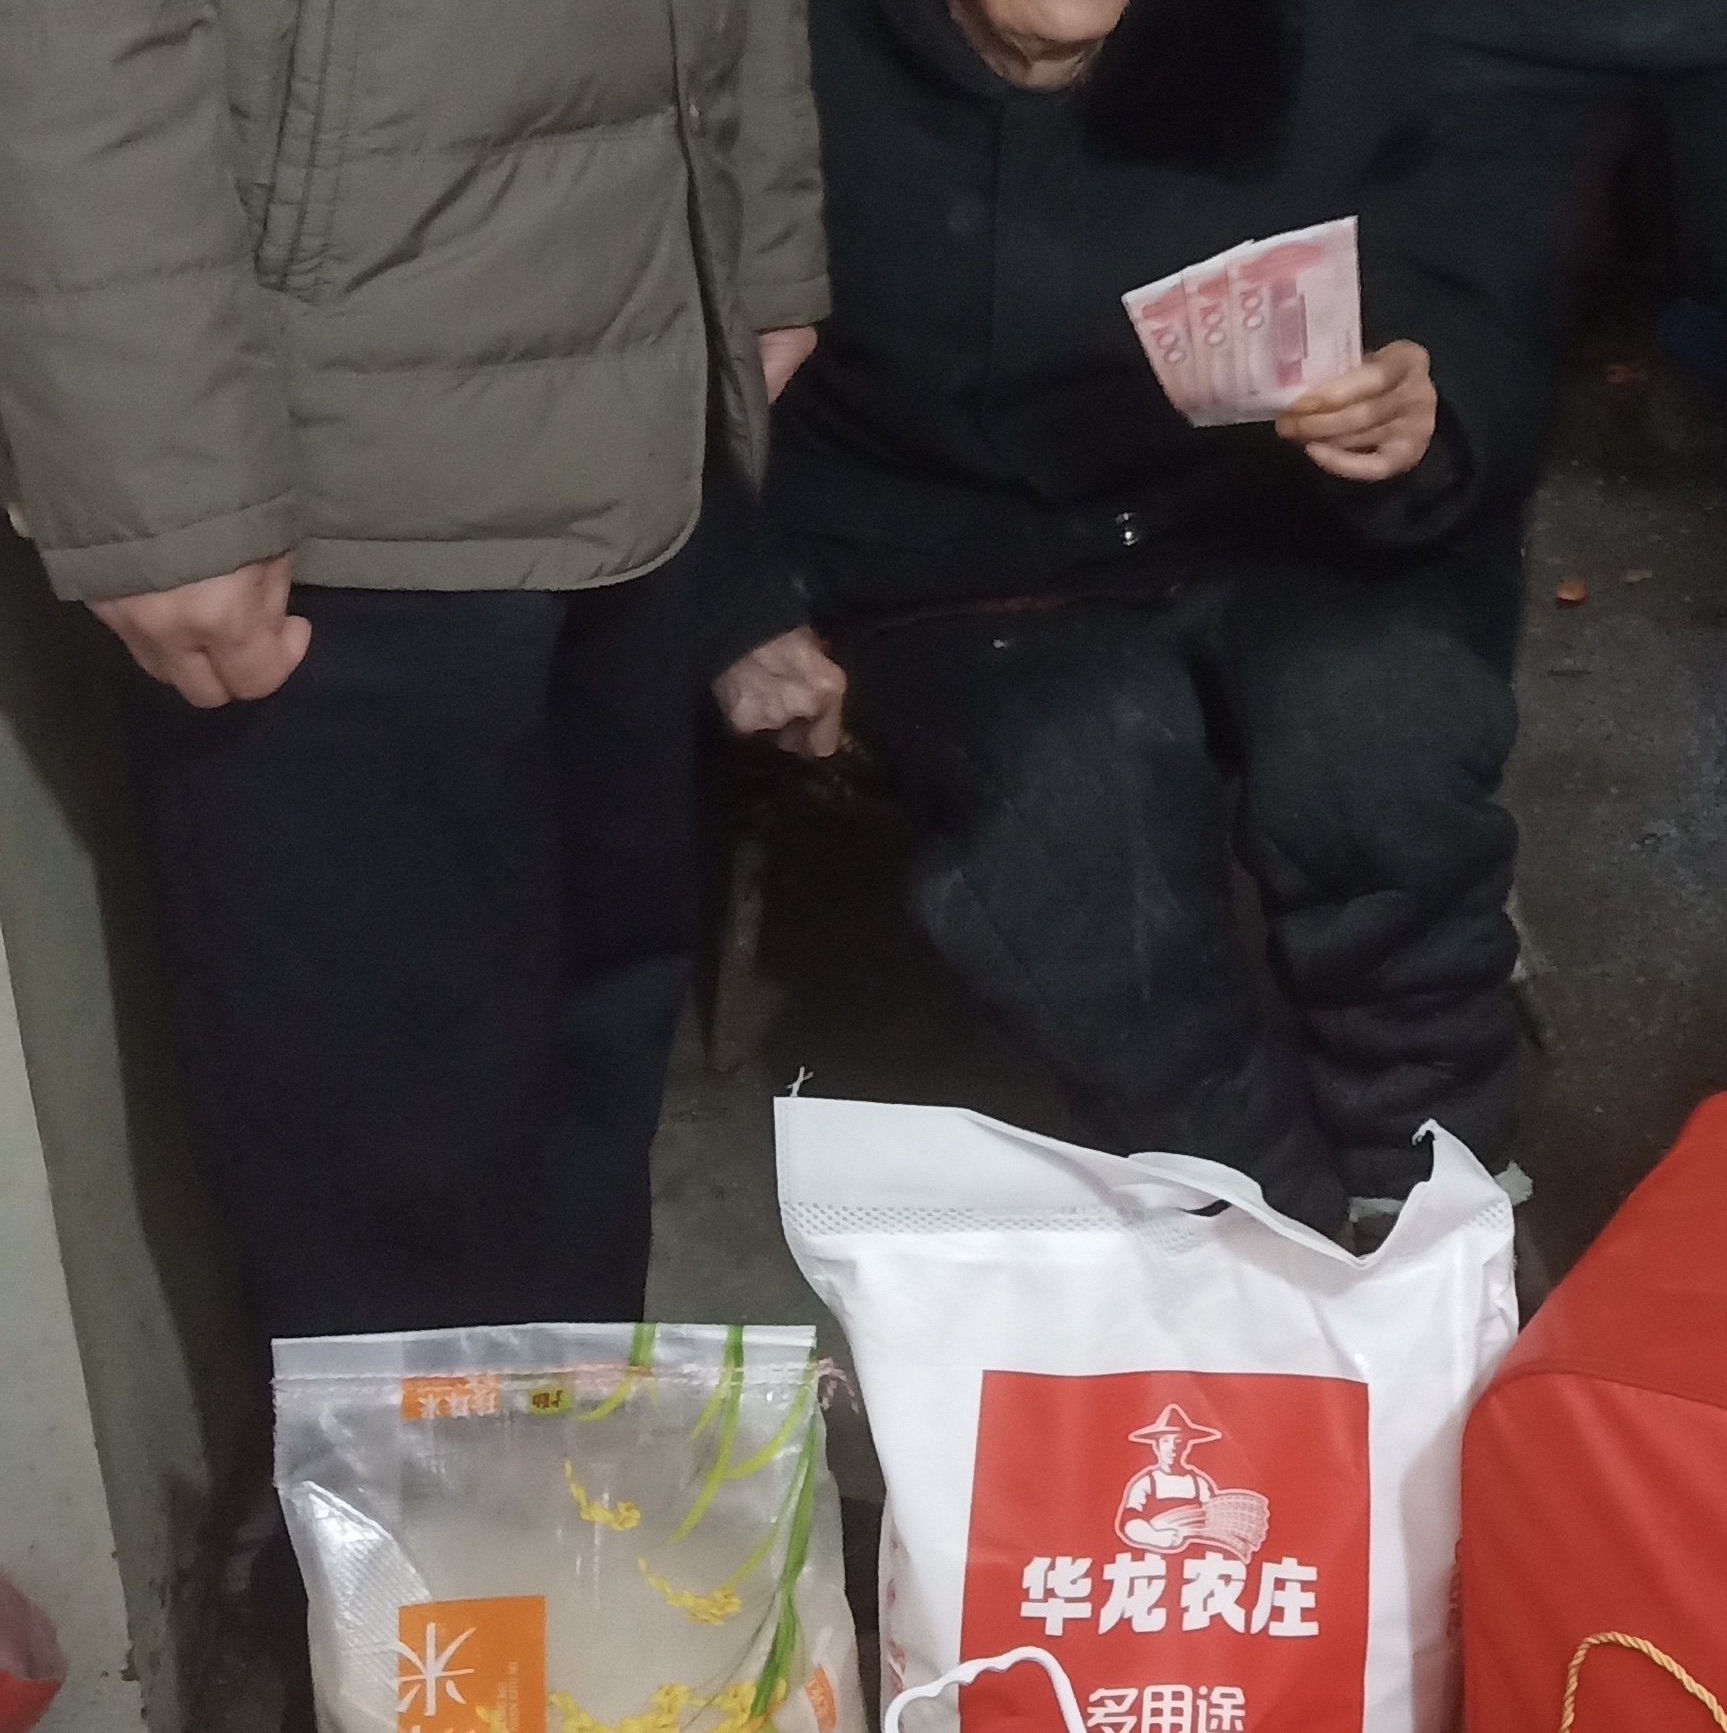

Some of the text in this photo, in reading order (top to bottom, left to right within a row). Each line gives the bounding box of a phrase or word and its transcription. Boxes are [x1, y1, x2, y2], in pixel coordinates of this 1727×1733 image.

[1020, 1551, 1319, 1637] 华龙农庄
[1086, 1683, 1246, 1733] 多用途
